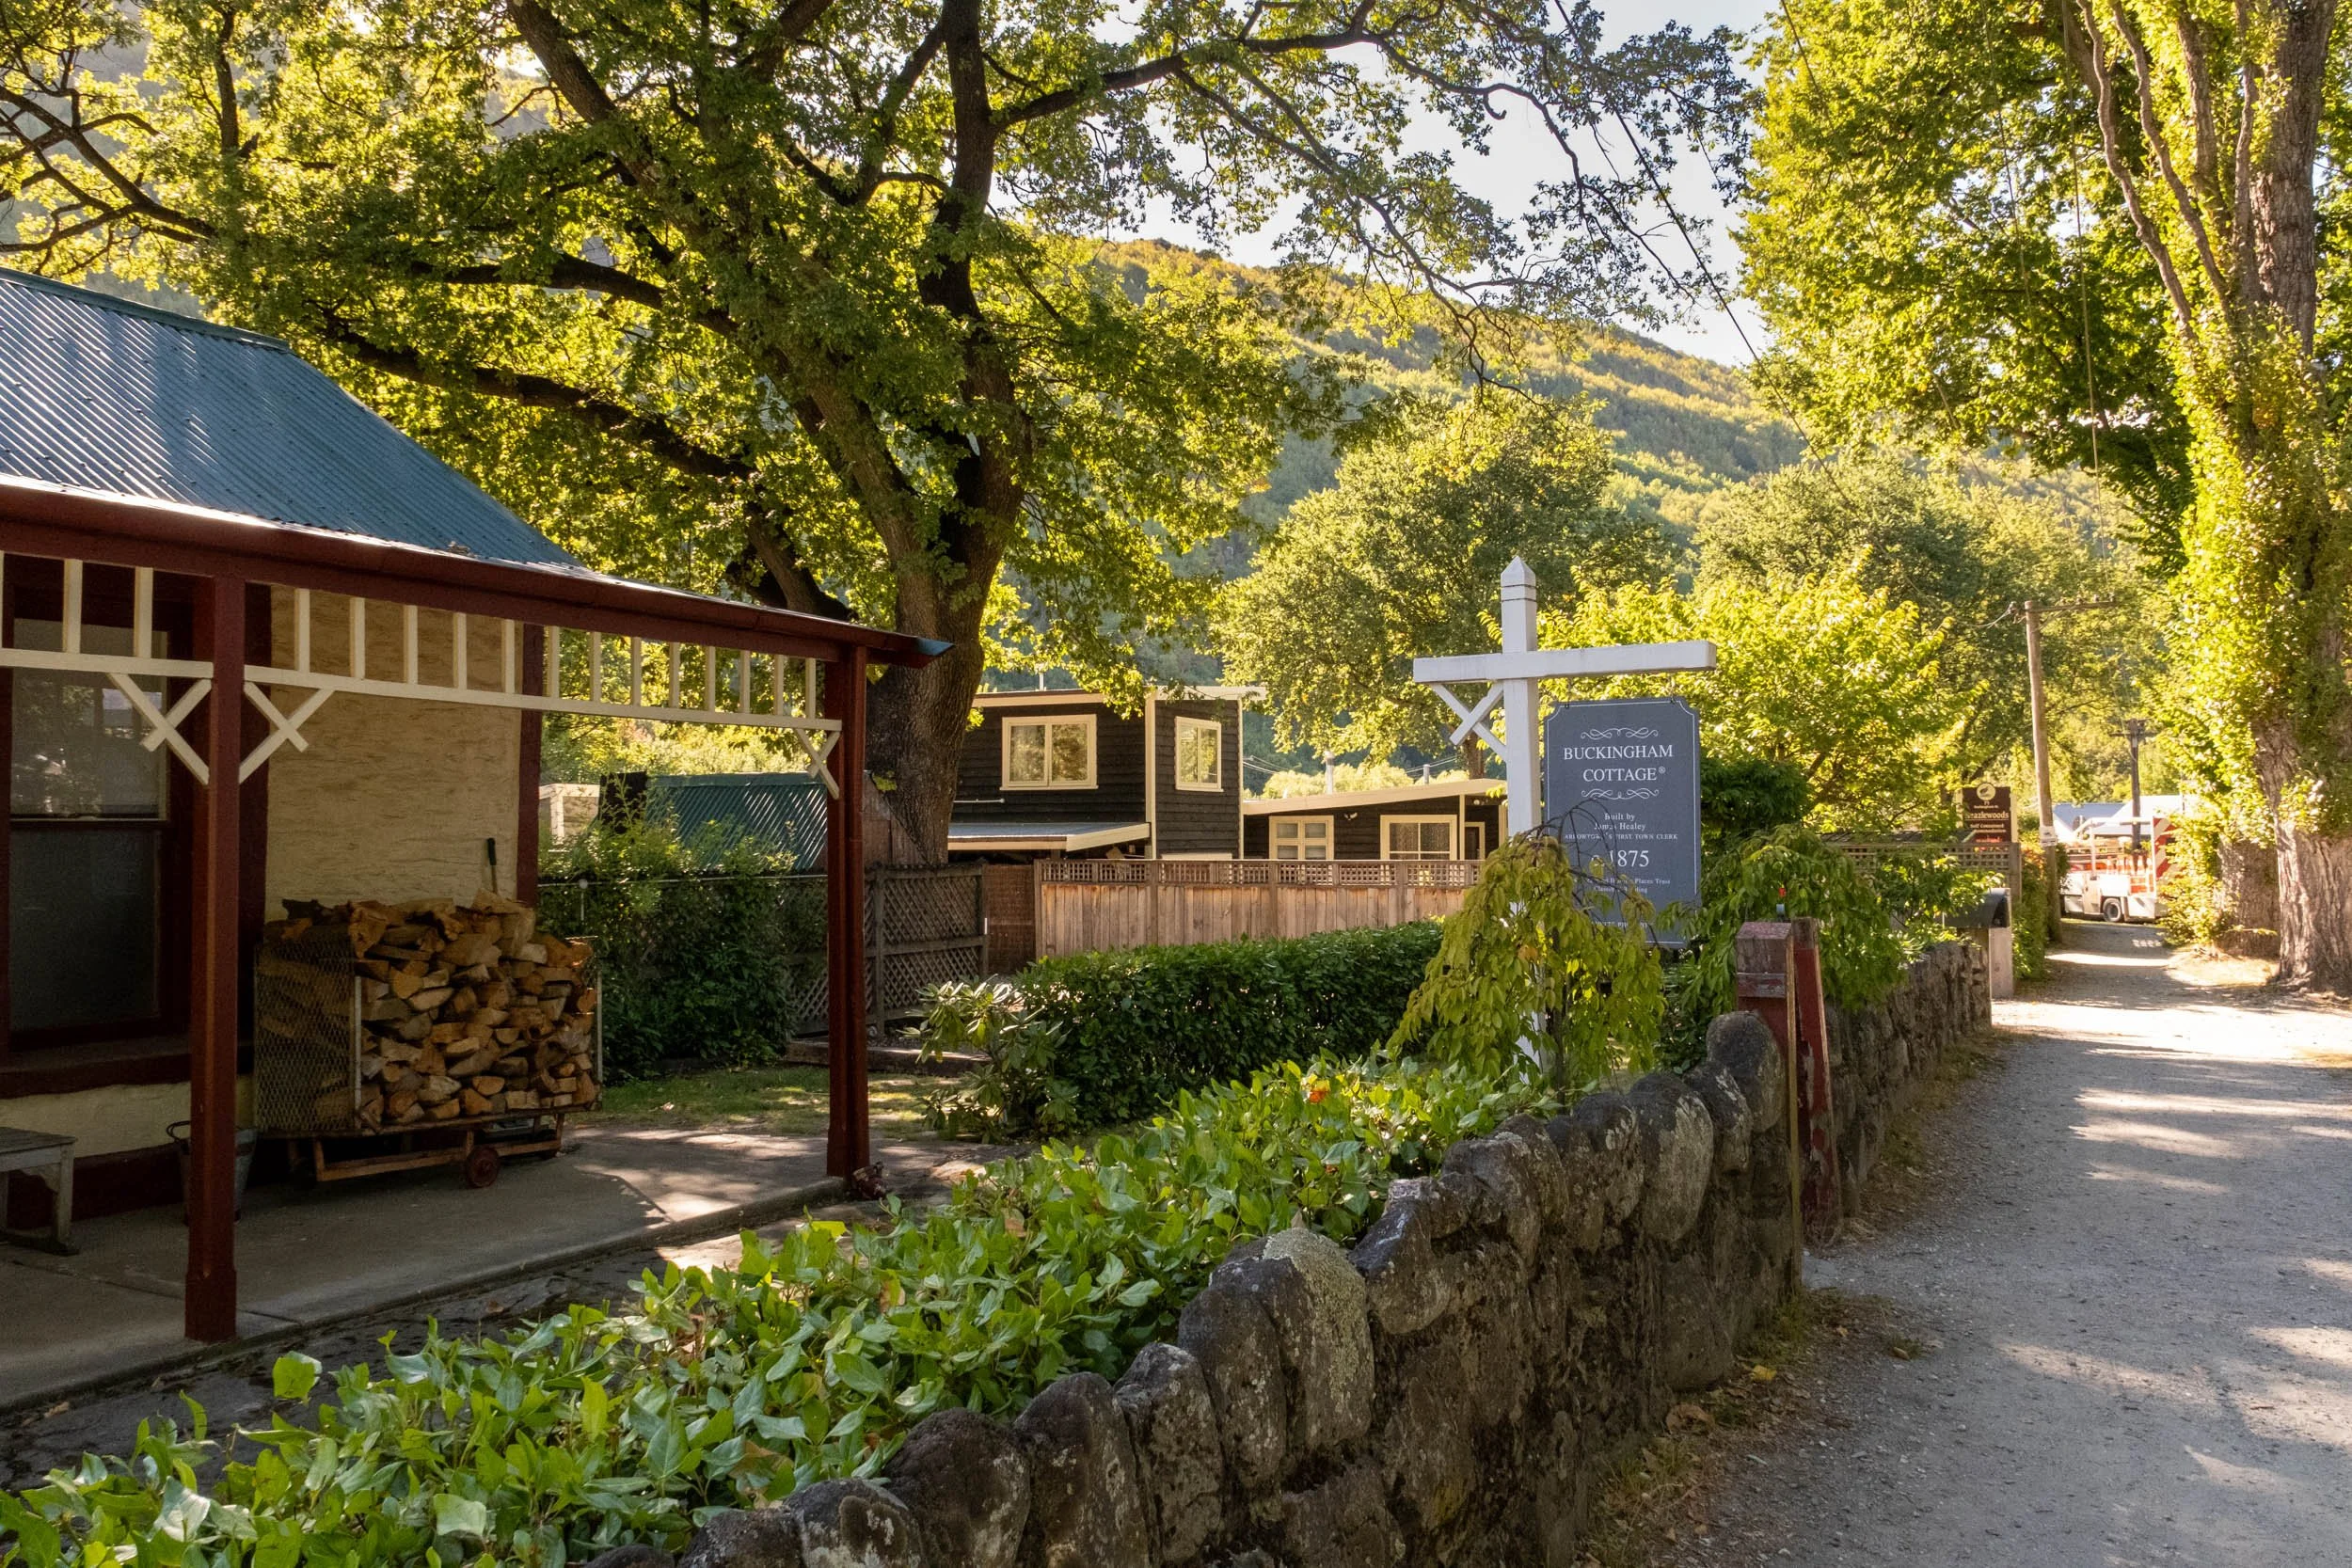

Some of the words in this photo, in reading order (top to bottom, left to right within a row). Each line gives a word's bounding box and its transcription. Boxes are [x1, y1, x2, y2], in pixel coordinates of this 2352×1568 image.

[1564, 744, 1674, 760] BUCKINGHAM
[1604, 812, 1625, 821] Built
[1626, 812, 1635, 822] by
[1619, 822, 1646, 832] Healey
[1609, 849, 1650, 867] 1875
